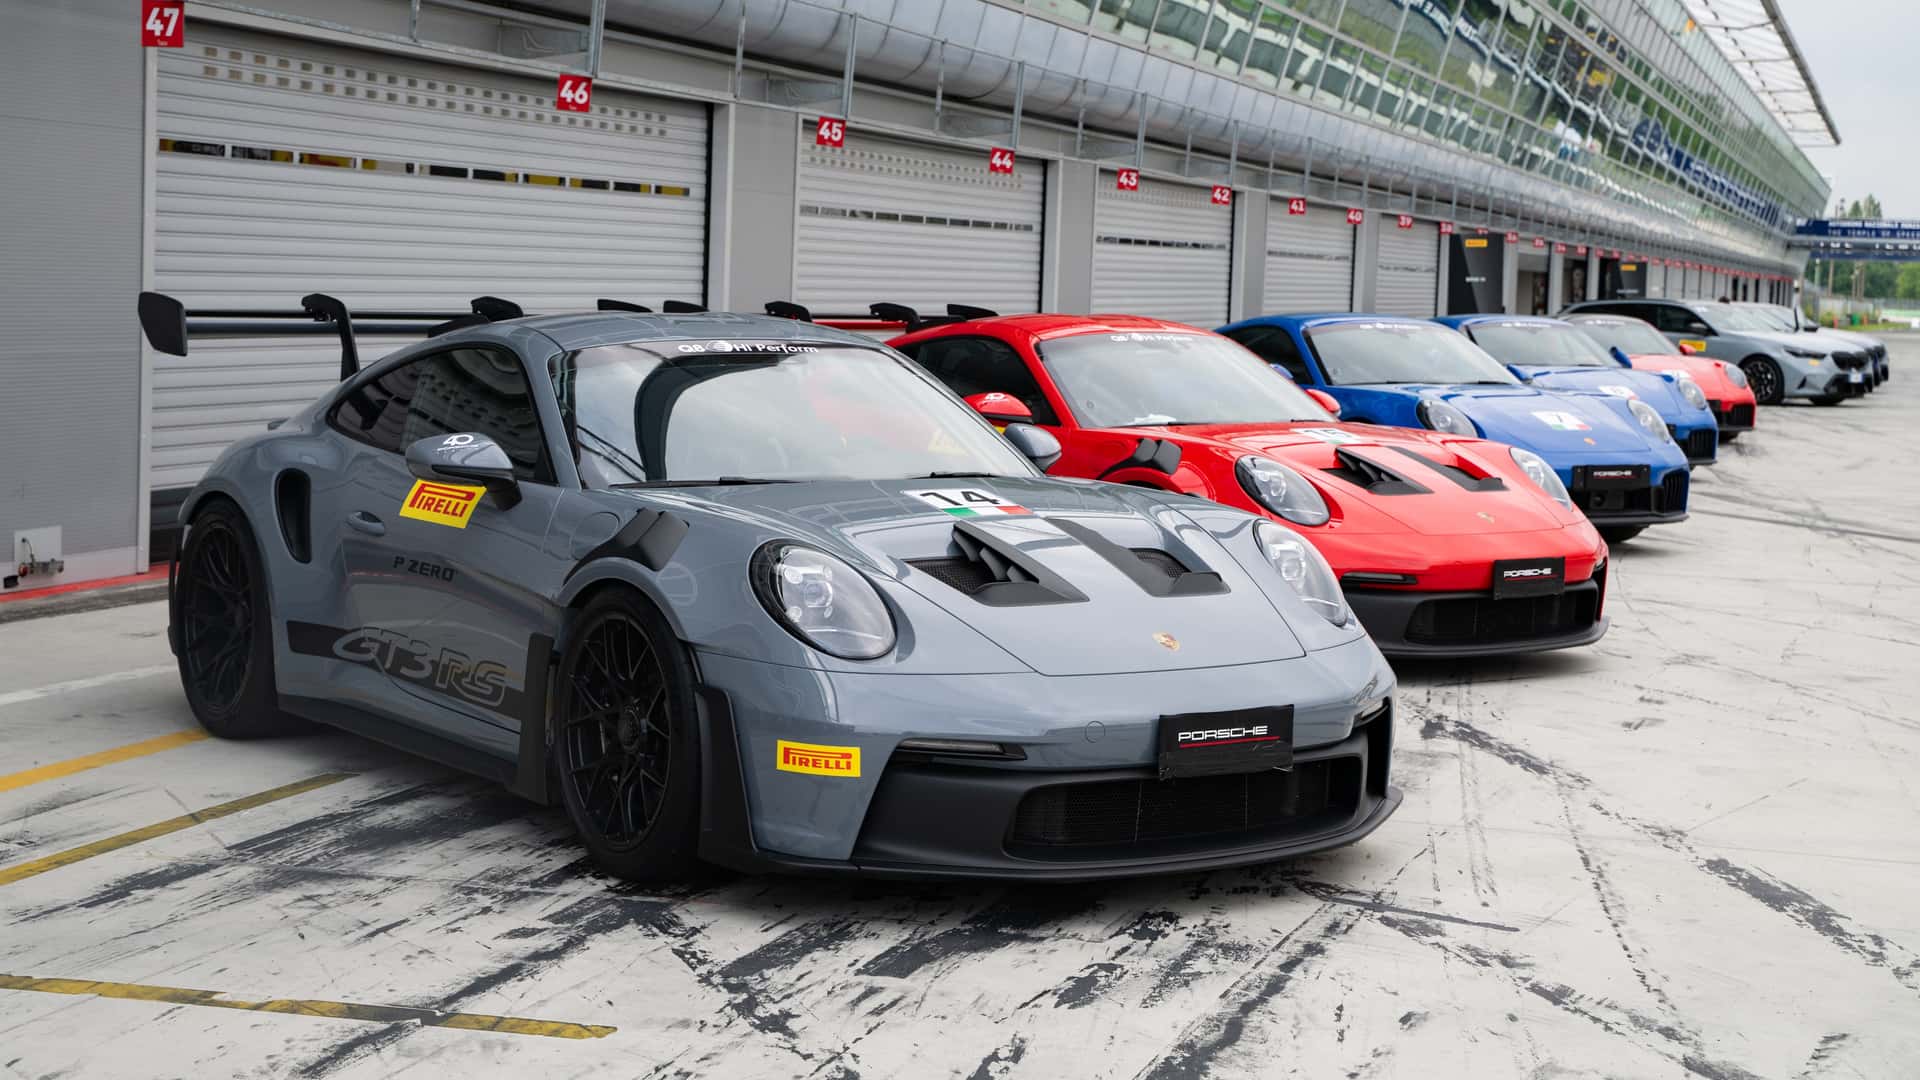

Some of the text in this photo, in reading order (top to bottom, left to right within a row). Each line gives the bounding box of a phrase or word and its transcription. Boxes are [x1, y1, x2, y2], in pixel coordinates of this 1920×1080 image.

[146, 7, 179, 37] 47
[560, 80, 588, 105] 46
[819, 121, 842, 141] 45
[992, 151, 1013, 169] 44
[1119, 171, 1137, 186] 43
[1214, 187, 1230, 201] 42
[1290, 199, 1304, 212] 41
[1348, 209, 1362, 222] 40
[1399, 215, 1412, 226] 39
[755, 344, 819, 353] Perform
[443, 434, 474, 446] 40
[408, 483, 476, 517] PIRELLI
[920, 491, 1000, 506] 14
[393, 556, 456, 582] P ZERO
[1503, 567, 1551, 578] PORSCHE
[1178, 725, 1268, 742] PORSCHE
[783, 747, 852, 770] PIRELLI
